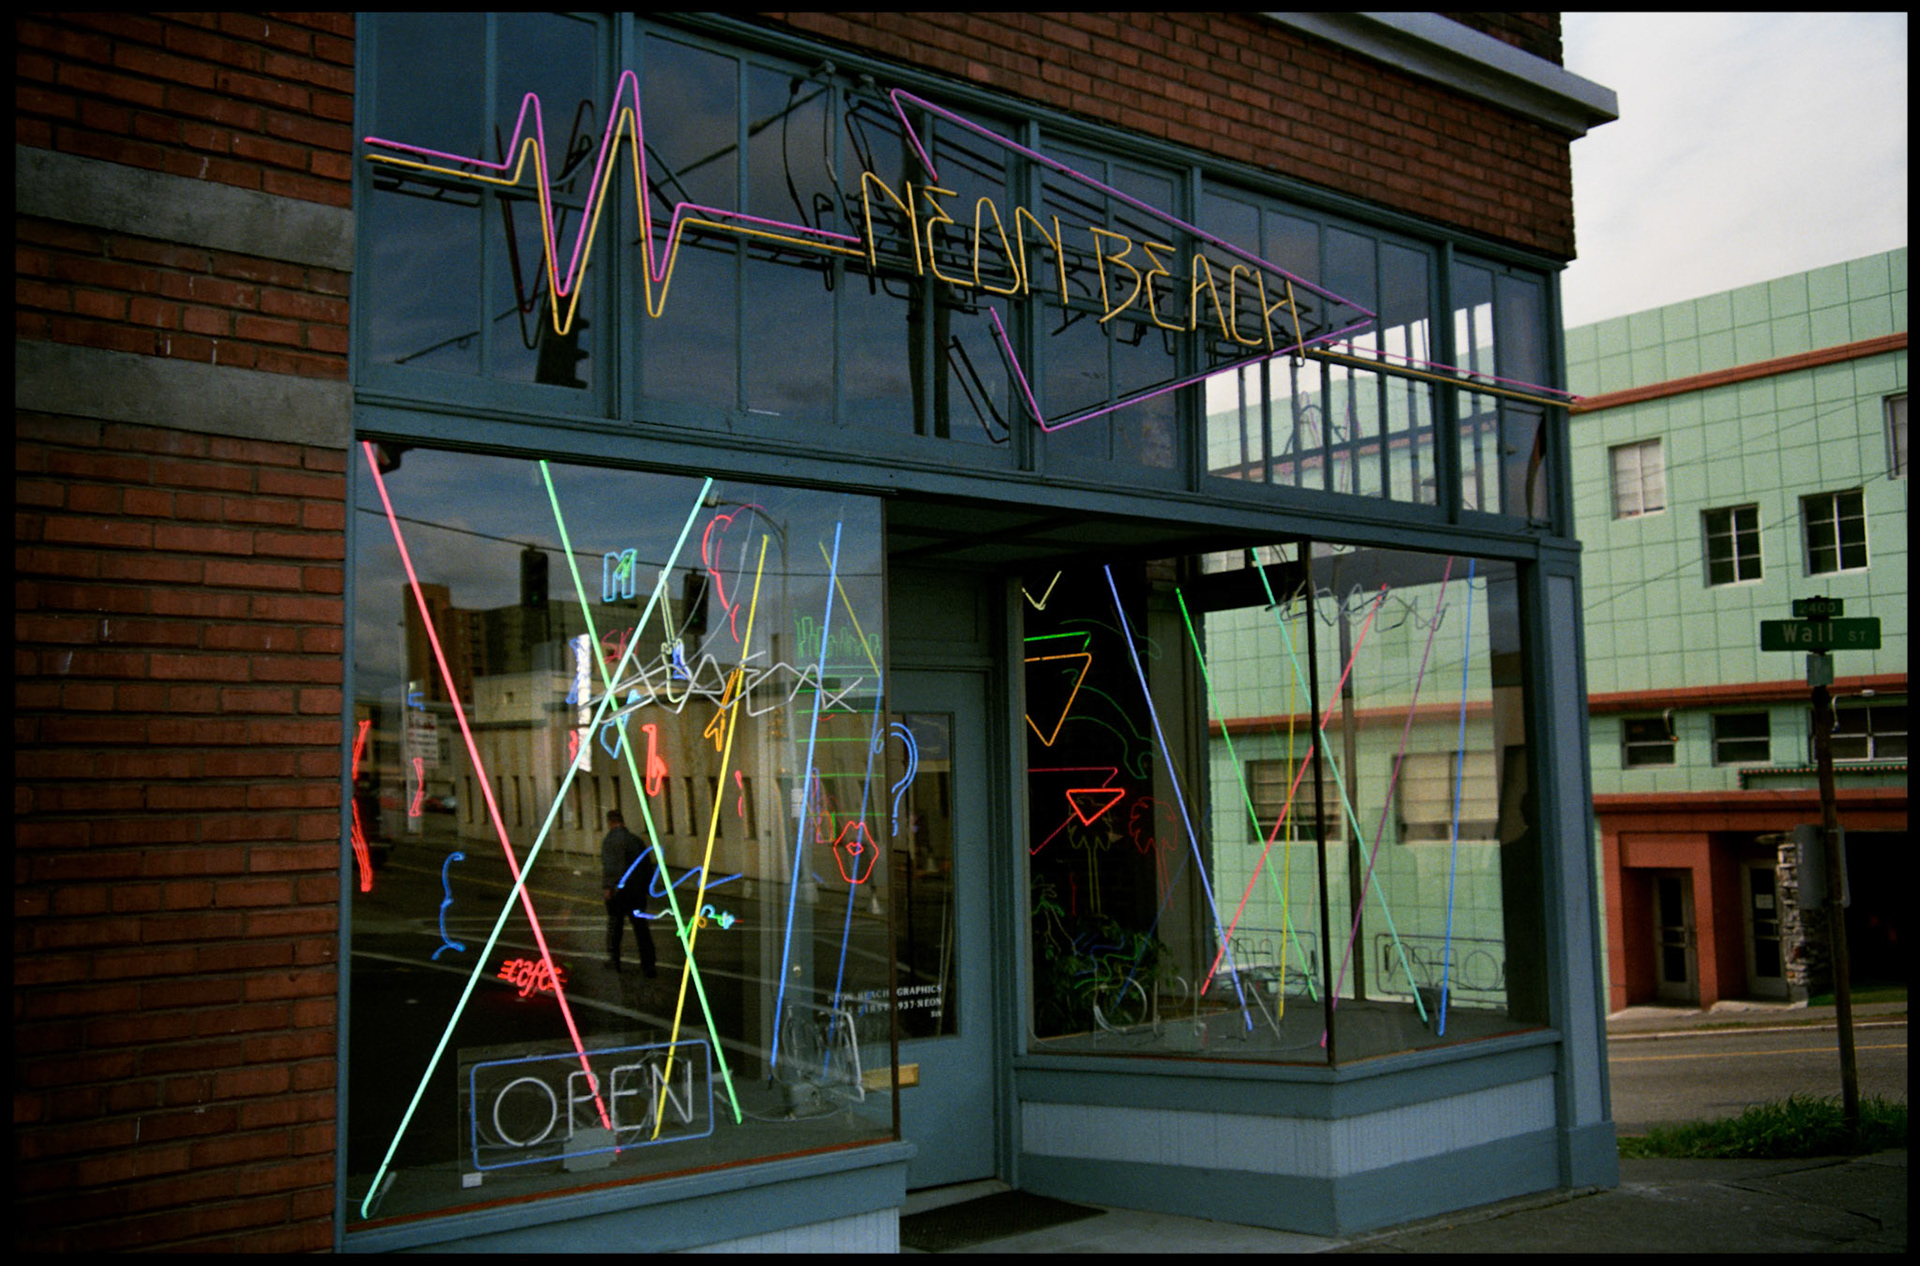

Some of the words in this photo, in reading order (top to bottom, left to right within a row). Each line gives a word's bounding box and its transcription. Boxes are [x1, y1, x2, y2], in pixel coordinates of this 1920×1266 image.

[860, 171, 1069, 304] NEON
[1089, 226, 1307, 362] BEACH
[1781, 622, 1834, 643] Wall
[1848, 630, 1867, 642] ST
[896, 984, 942, 997] GRAPHICS
[493, 1060, 693, 1147] OPEN
